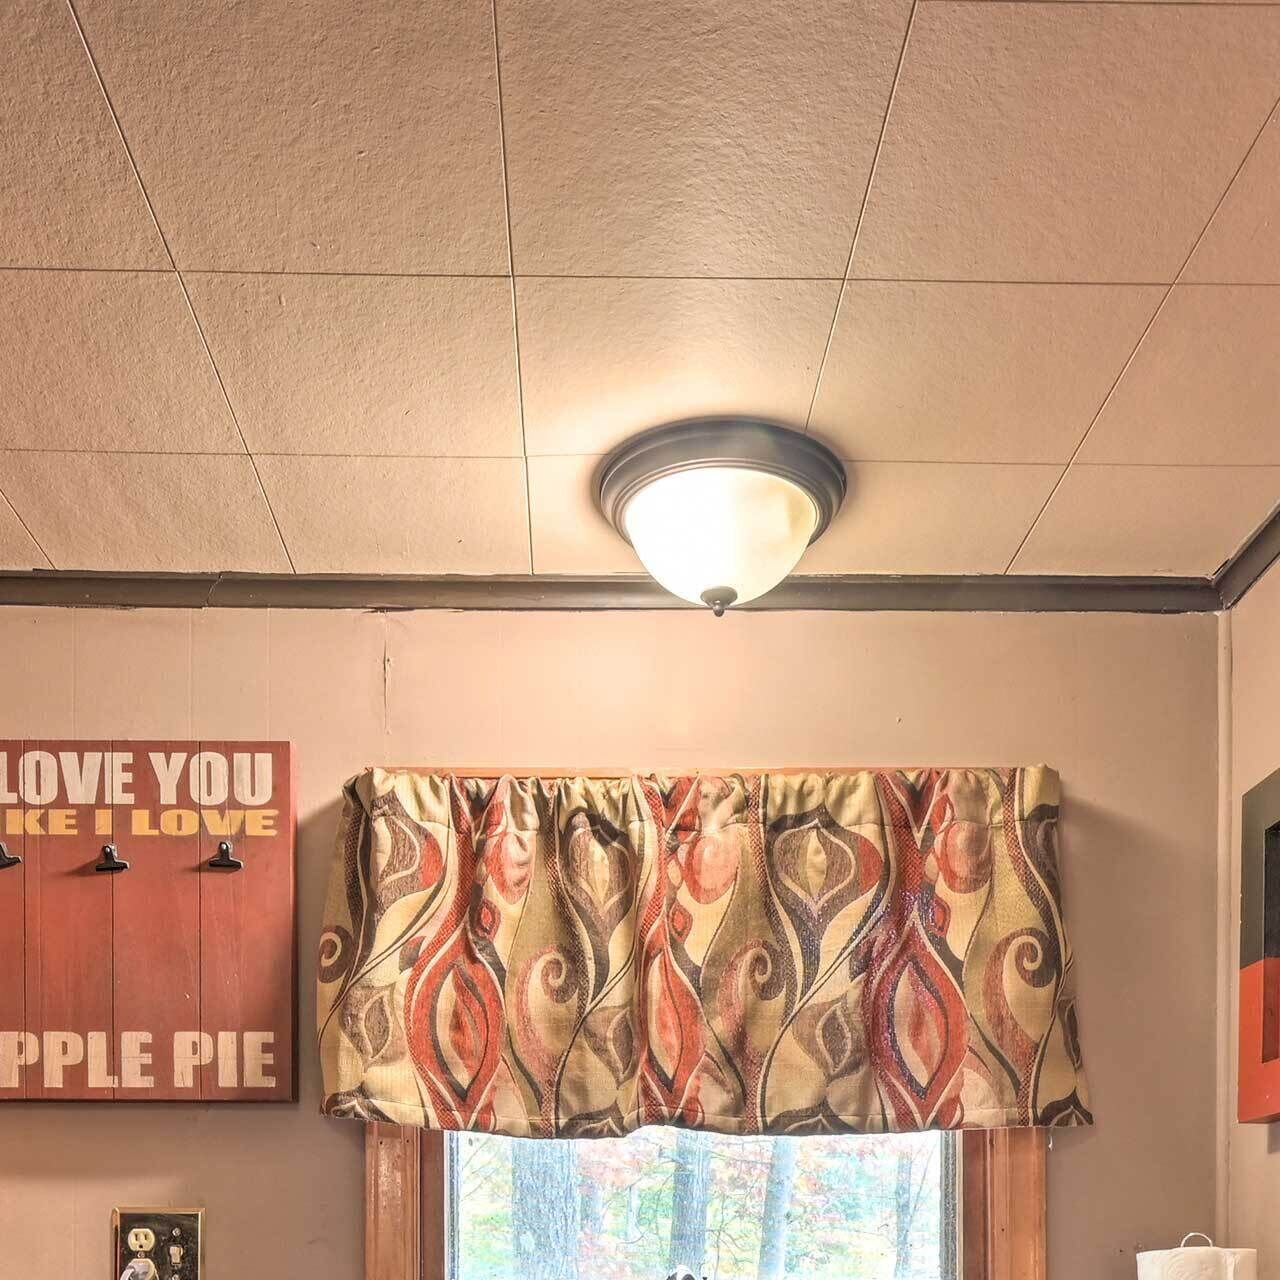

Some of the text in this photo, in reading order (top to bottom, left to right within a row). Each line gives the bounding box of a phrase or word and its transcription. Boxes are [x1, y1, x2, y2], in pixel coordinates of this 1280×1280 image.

[148, 751, 274, 806] YOU
[95, 809, 113, 836] I
[131, 808, 280, 837] LOVE
[173, 1030, 277, 1089] PIE
